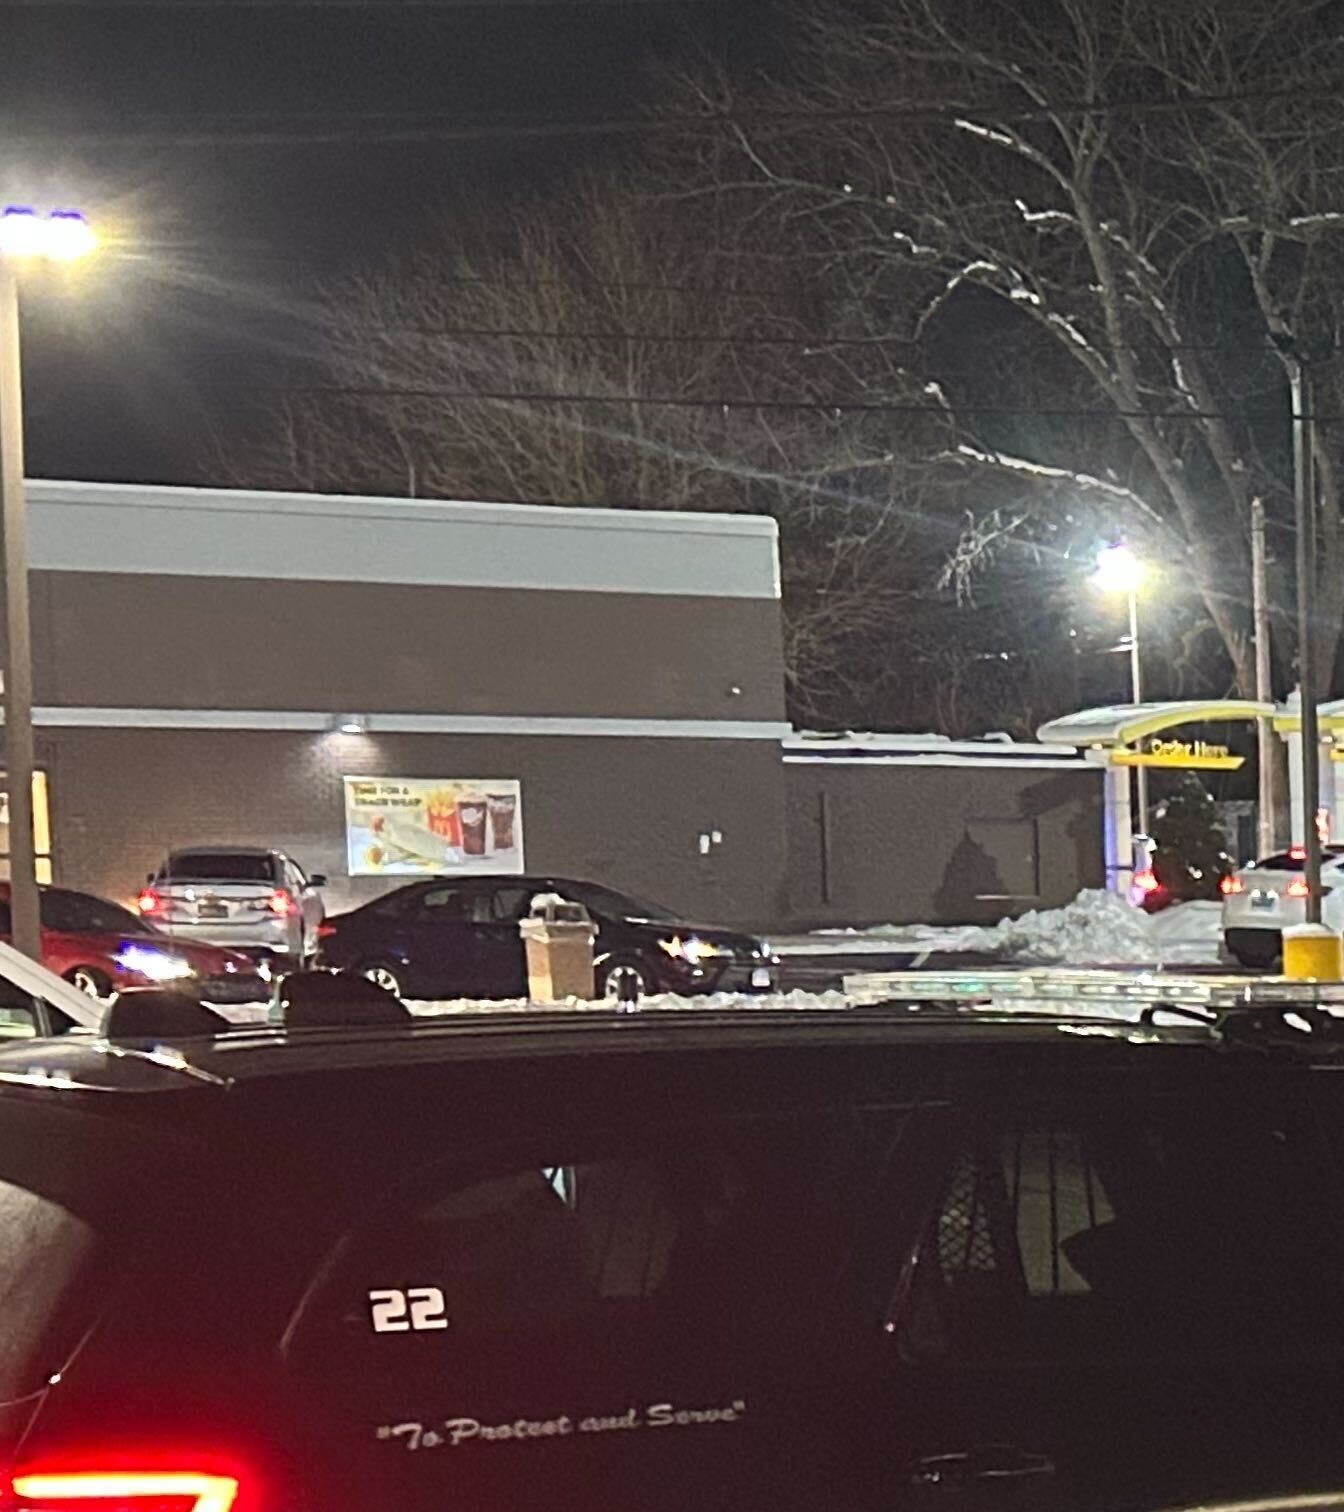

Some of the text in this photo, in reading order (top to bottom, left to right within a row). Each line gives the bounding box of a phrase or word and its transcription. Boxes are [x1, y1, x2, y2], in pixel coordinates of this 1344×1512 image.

[1151, 738, 1229, 758] Order Here
[368, 1286, 449, 1333] 22
[444, 1416, 570, 1447] Protect
[579, 1408, 641, 1433] and
